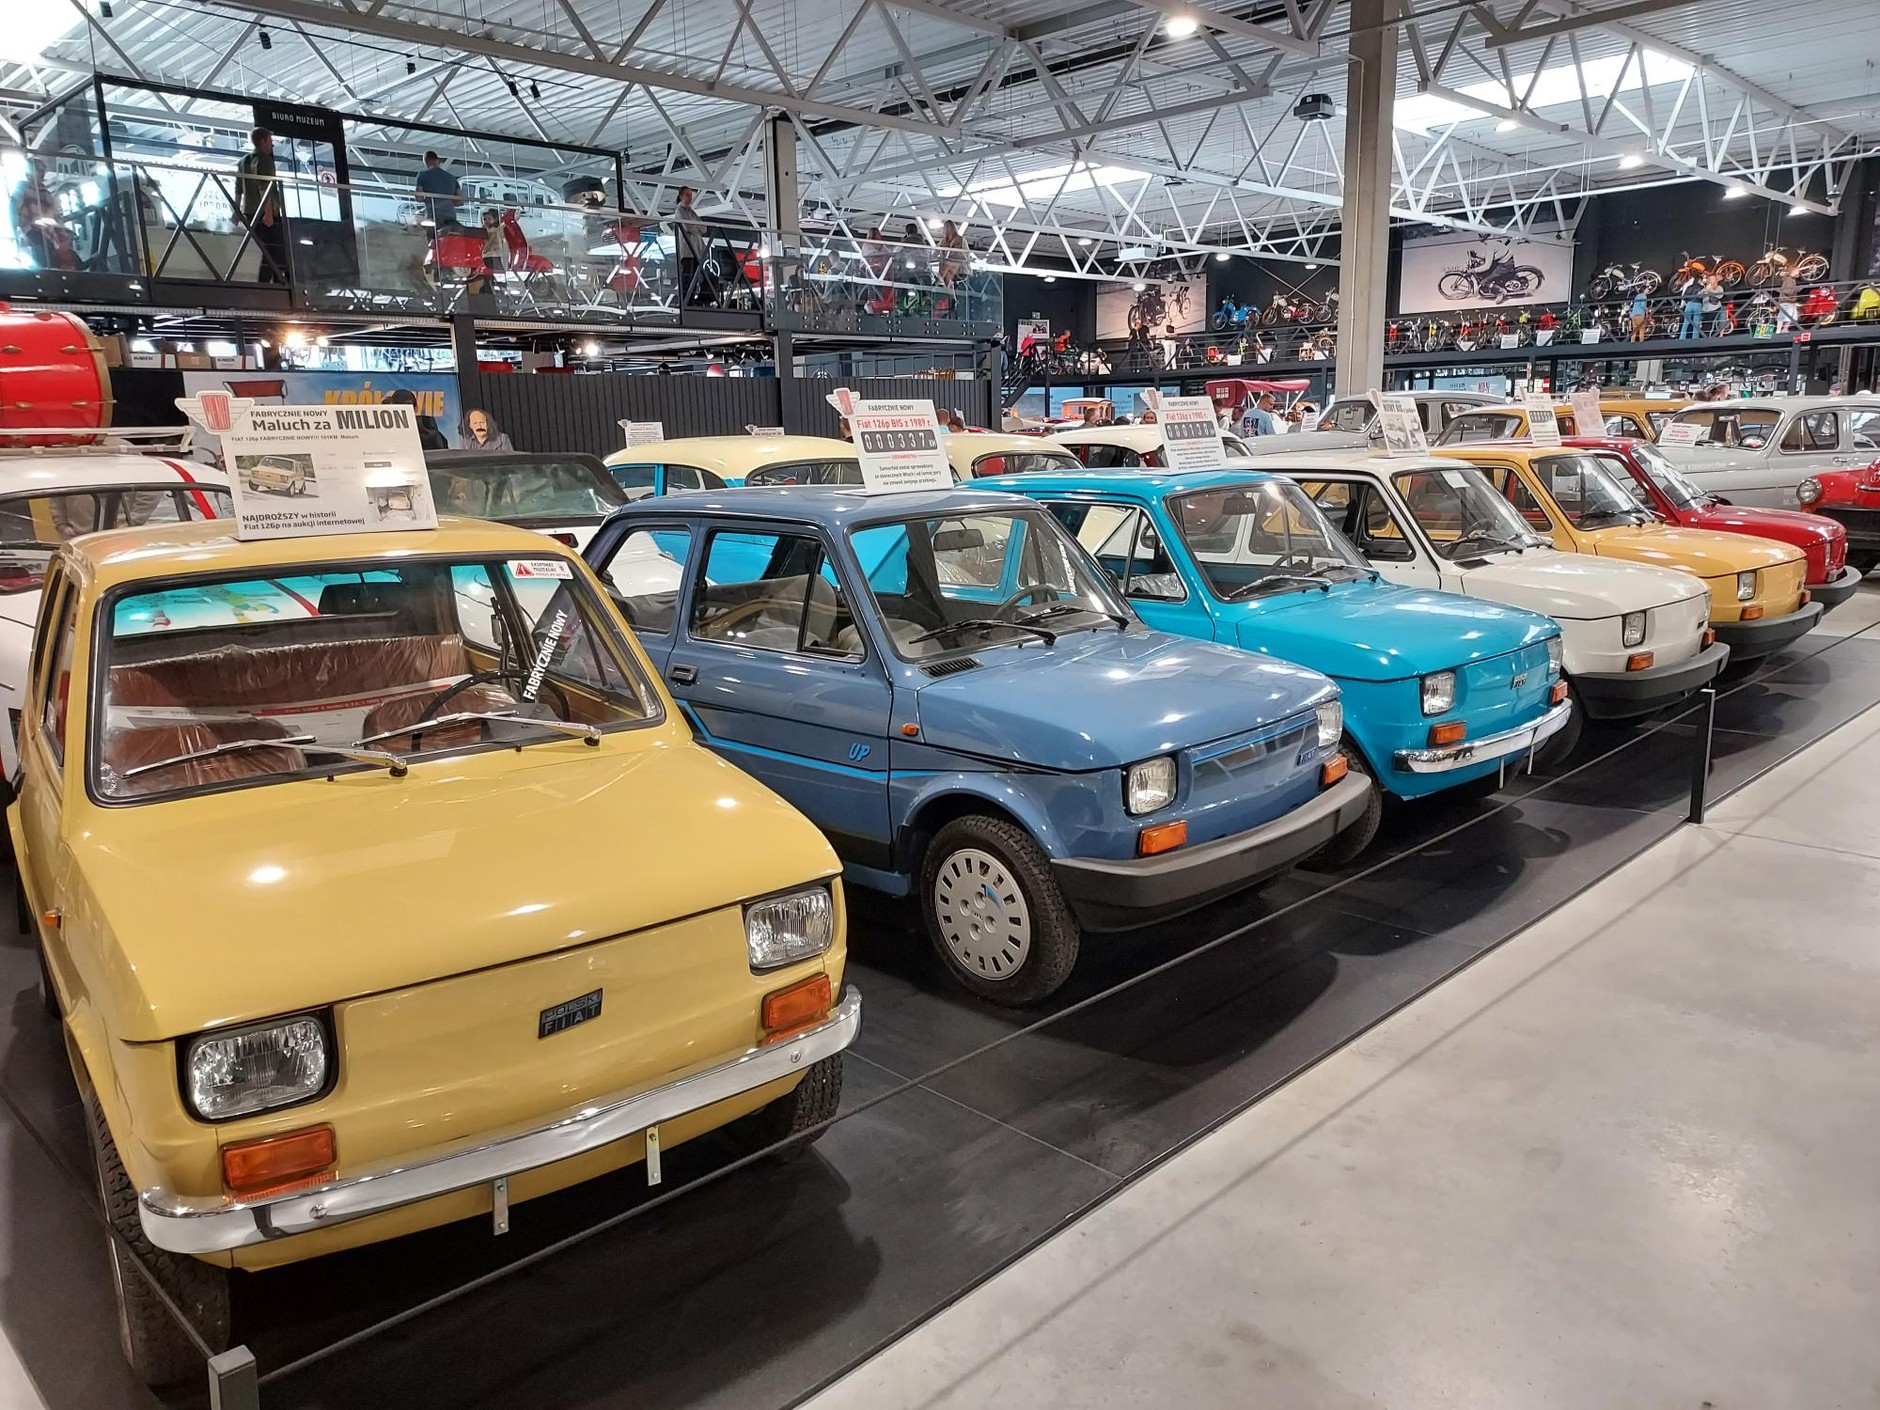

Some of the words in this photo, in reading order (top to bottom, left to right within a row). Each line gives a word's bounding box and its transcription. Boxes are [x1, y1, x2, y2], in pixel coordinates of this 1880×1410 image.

[271, 112, 294, 122] BIURO
[296, 115, 325, 126] MUZEUM
[251, 410, 302, 418] FABRYCZNIE
[868, 404, 899, 412] FABRYCZNIE
[252, 418, 311, 432] Maluch
[314, 420, 331, 430] za
[336, 410, 410, 430] MILION
[856, 420, 871, 429] Fiat
[873, 419, 890, 430] 126p
[892, 418, 903, 428] BIS
[911, 418, 926, 427] 1989
[242, 512, 299, 523] NAJDROŻSZY
[261, 522, 281, 530] 126p
[292, 520, 316, 529] aukcji
[317, 518, 365, 527] internetowej
[523, 637, 557, 701] FABRYCZNIE
[550, 608, 569, 641] NOWY
[849, 742, 870, 762] UP
[543, 990, 601, 1021] POLSKI
[543, 1003, 600, 1035] FIAT
